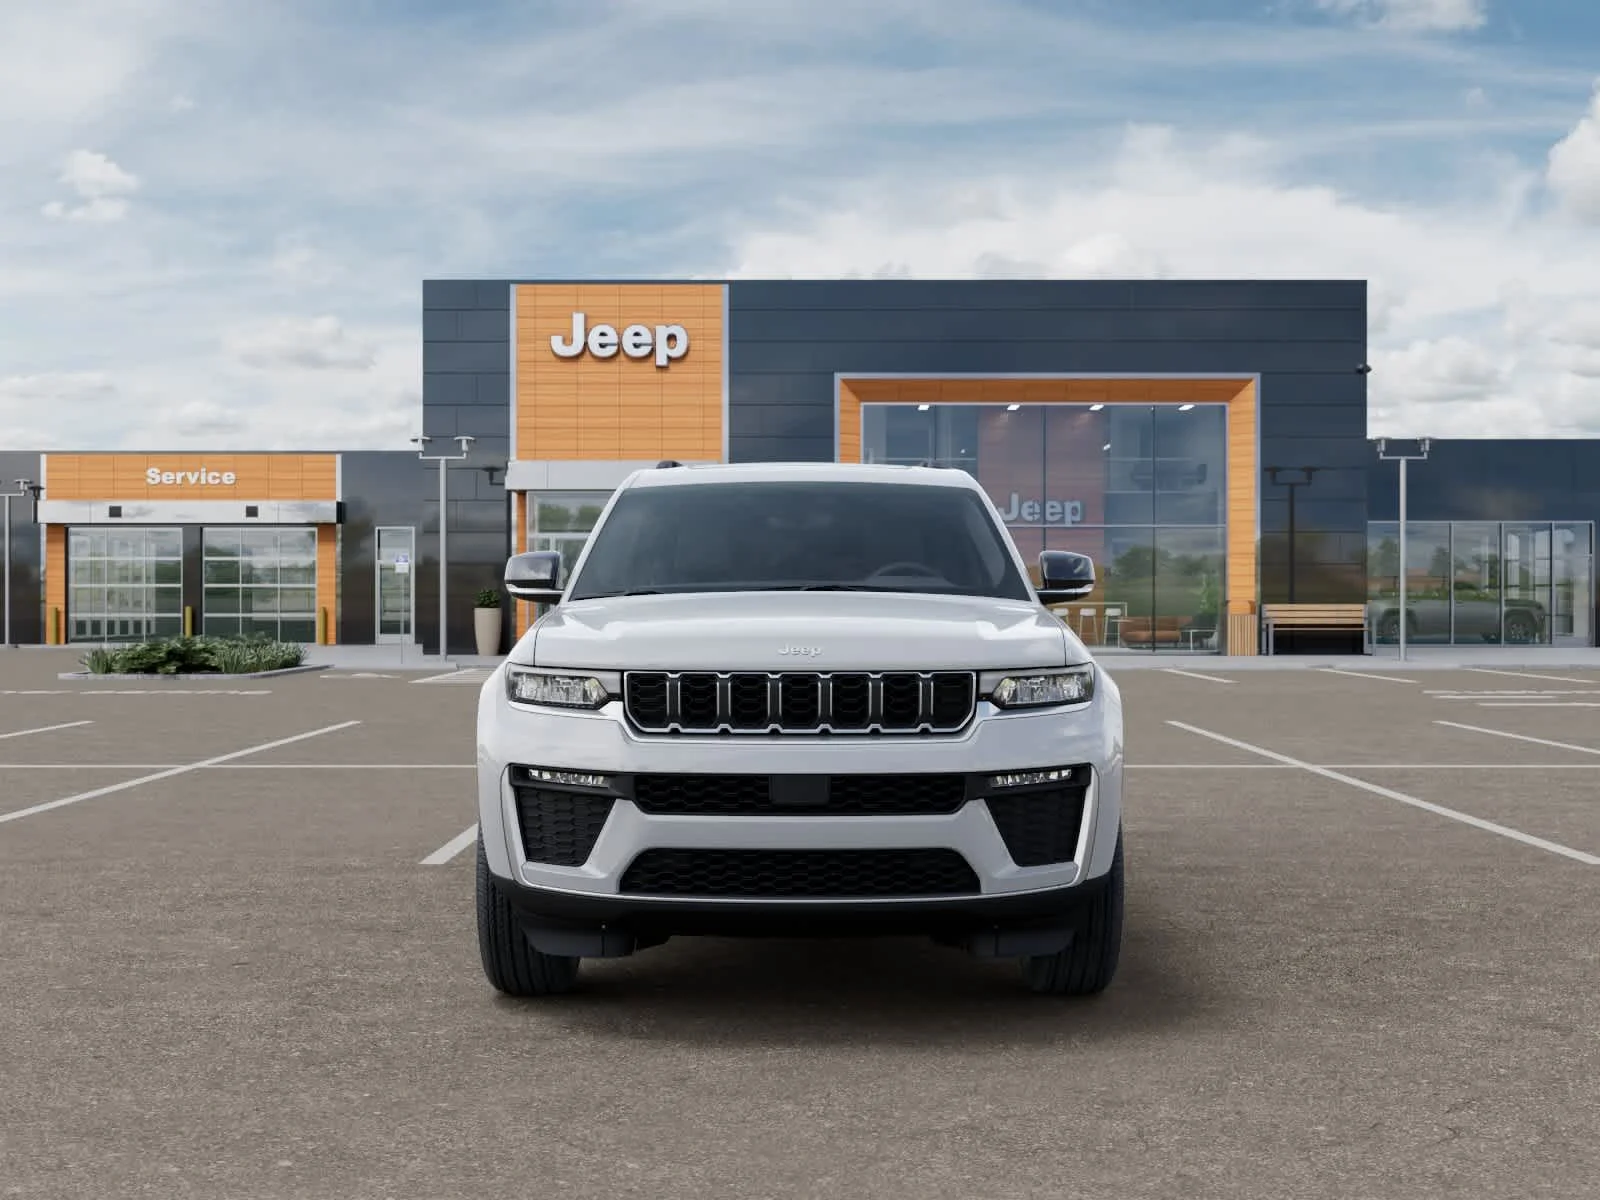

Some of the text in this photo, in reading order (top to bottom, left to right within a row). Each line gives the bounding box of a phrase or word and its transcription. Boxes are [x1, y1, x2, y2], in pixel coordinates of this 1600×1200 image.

[550, 312, 689, 367] Jeep
[146, 467, 236, 485] Service
[998, 493, 1083, 526] Jeep
[778, 642, 821, 657] Jeep
